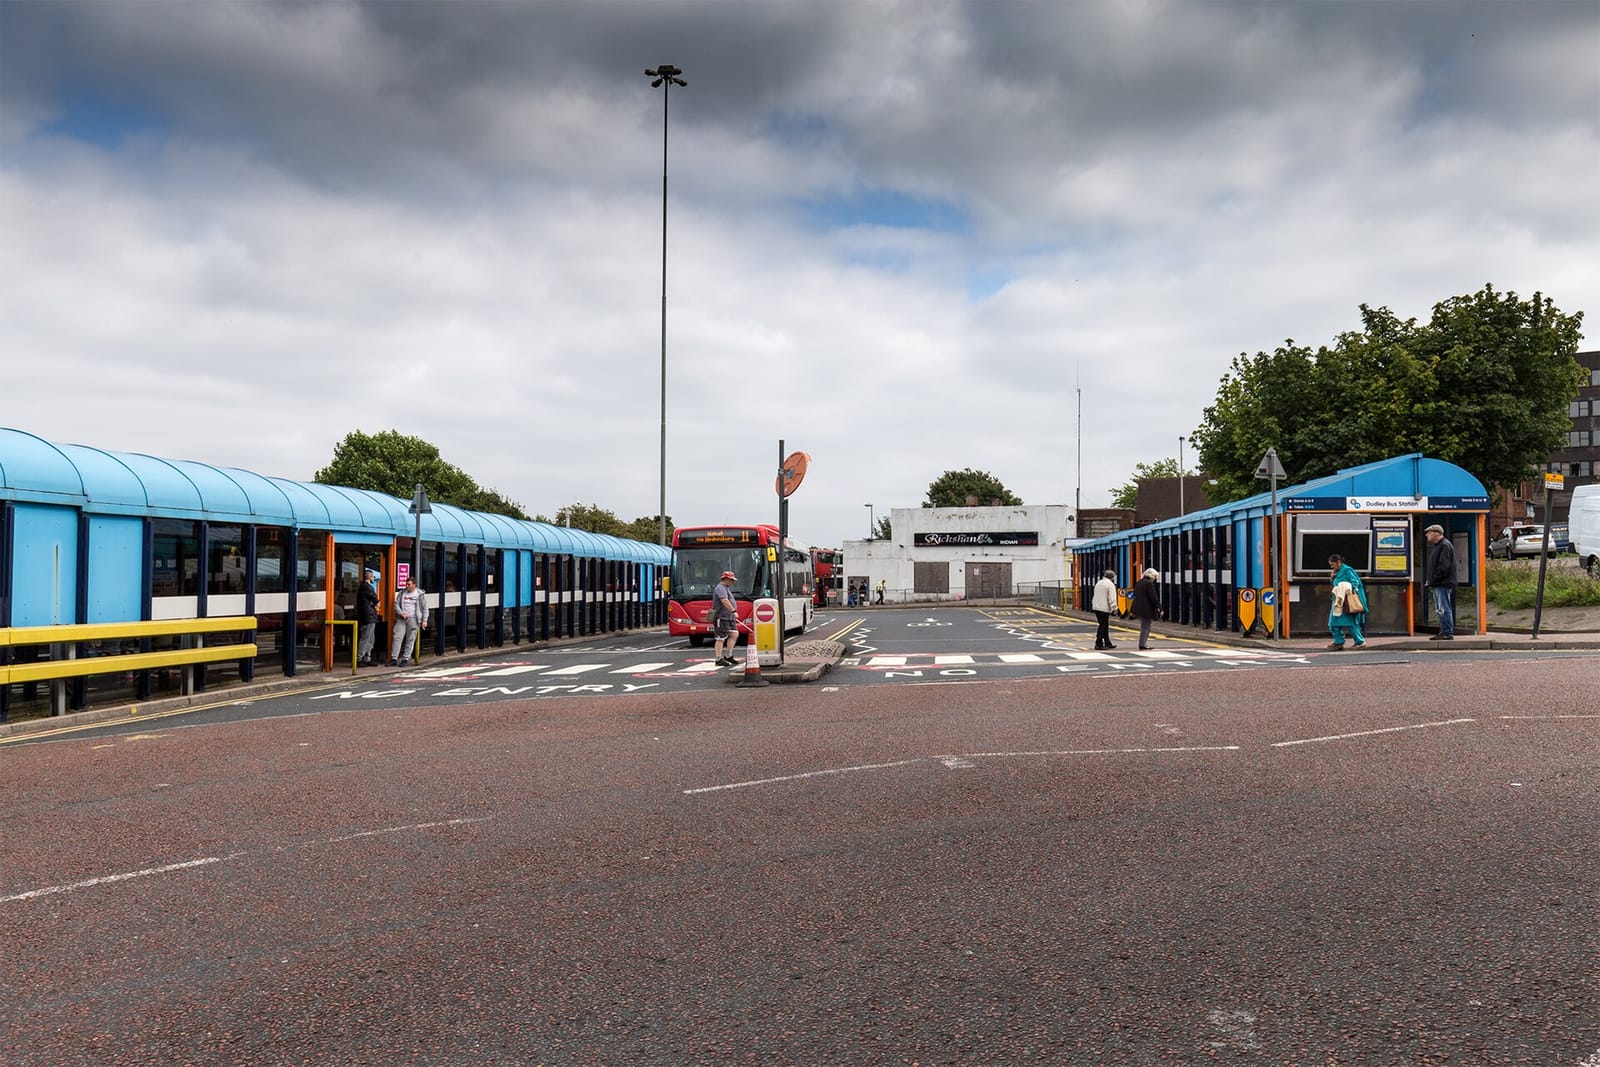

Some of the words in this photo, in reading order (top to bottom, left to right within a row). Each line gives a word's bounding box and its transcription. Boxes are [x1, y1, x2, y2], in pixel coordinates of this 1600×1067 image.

[885, 669, 977, 678] NO
[1056, 657, 1312, 673] ENTRY
[308, 689, 417, 700] NO
[431, 683, 660, 696] ENTRY
